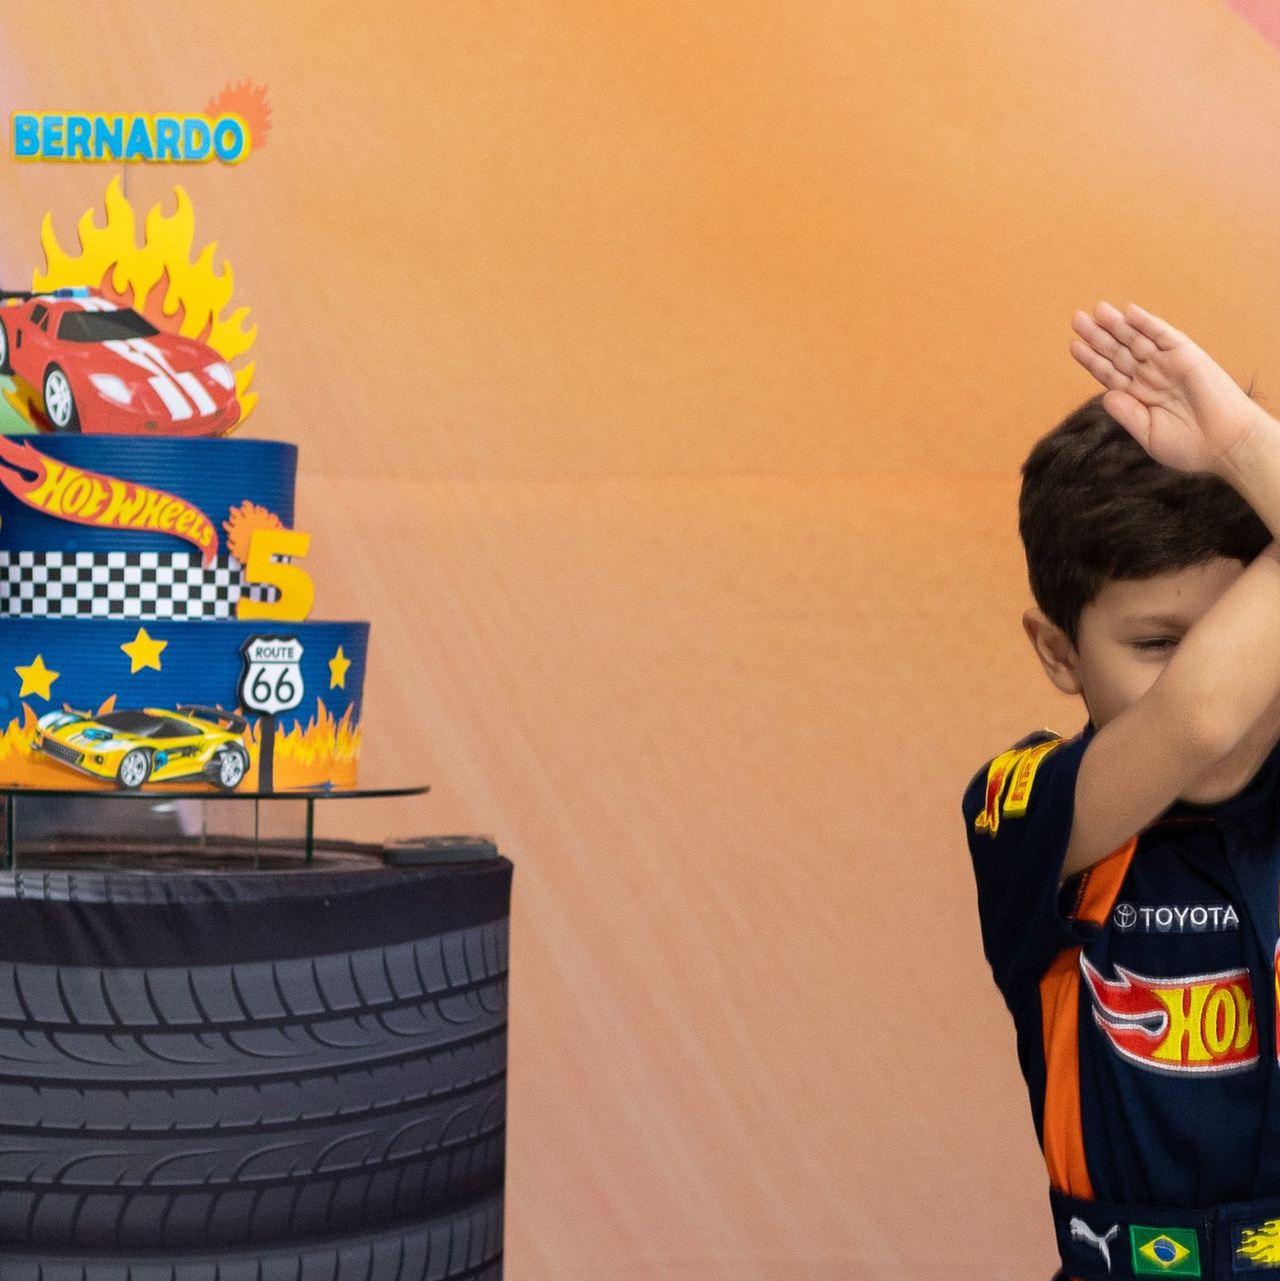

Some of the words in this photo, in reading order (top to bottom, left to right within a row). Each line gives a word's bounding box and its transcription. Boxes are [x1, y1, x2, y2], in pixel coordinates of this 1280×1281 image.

[14, 114, 247, 162] BERNARDO
[236, 529, 314, 620] 5
[255, 646, 295, 659] ROUTE
[251, 666, 296, 704] 66
[1139, 904, 1240, 927] TOYOTA
